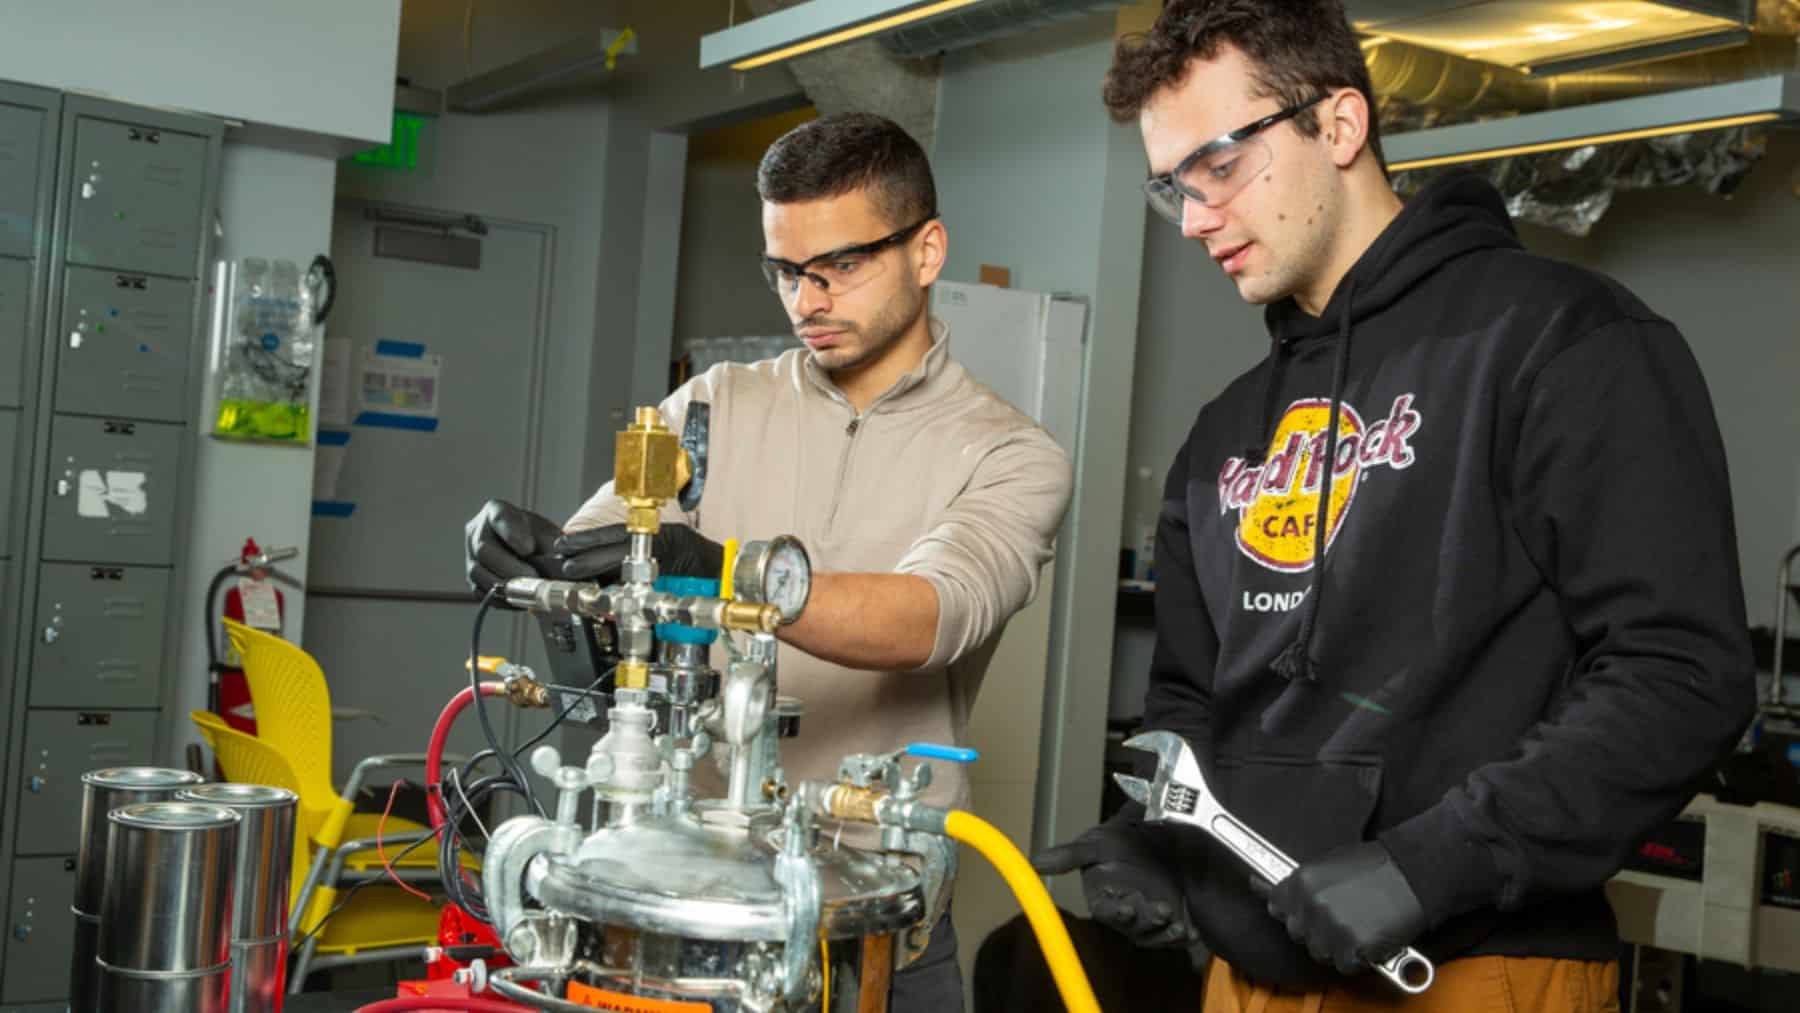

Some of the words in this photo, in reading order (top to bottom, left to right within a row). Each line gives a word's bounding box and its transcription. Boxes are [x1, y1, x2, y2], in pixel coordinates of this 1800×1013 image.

[1218, 431, 1305, 515] Had
[1262, 513, 1316, 538] CAF
[1243, 584, 1312, 612] LOND
